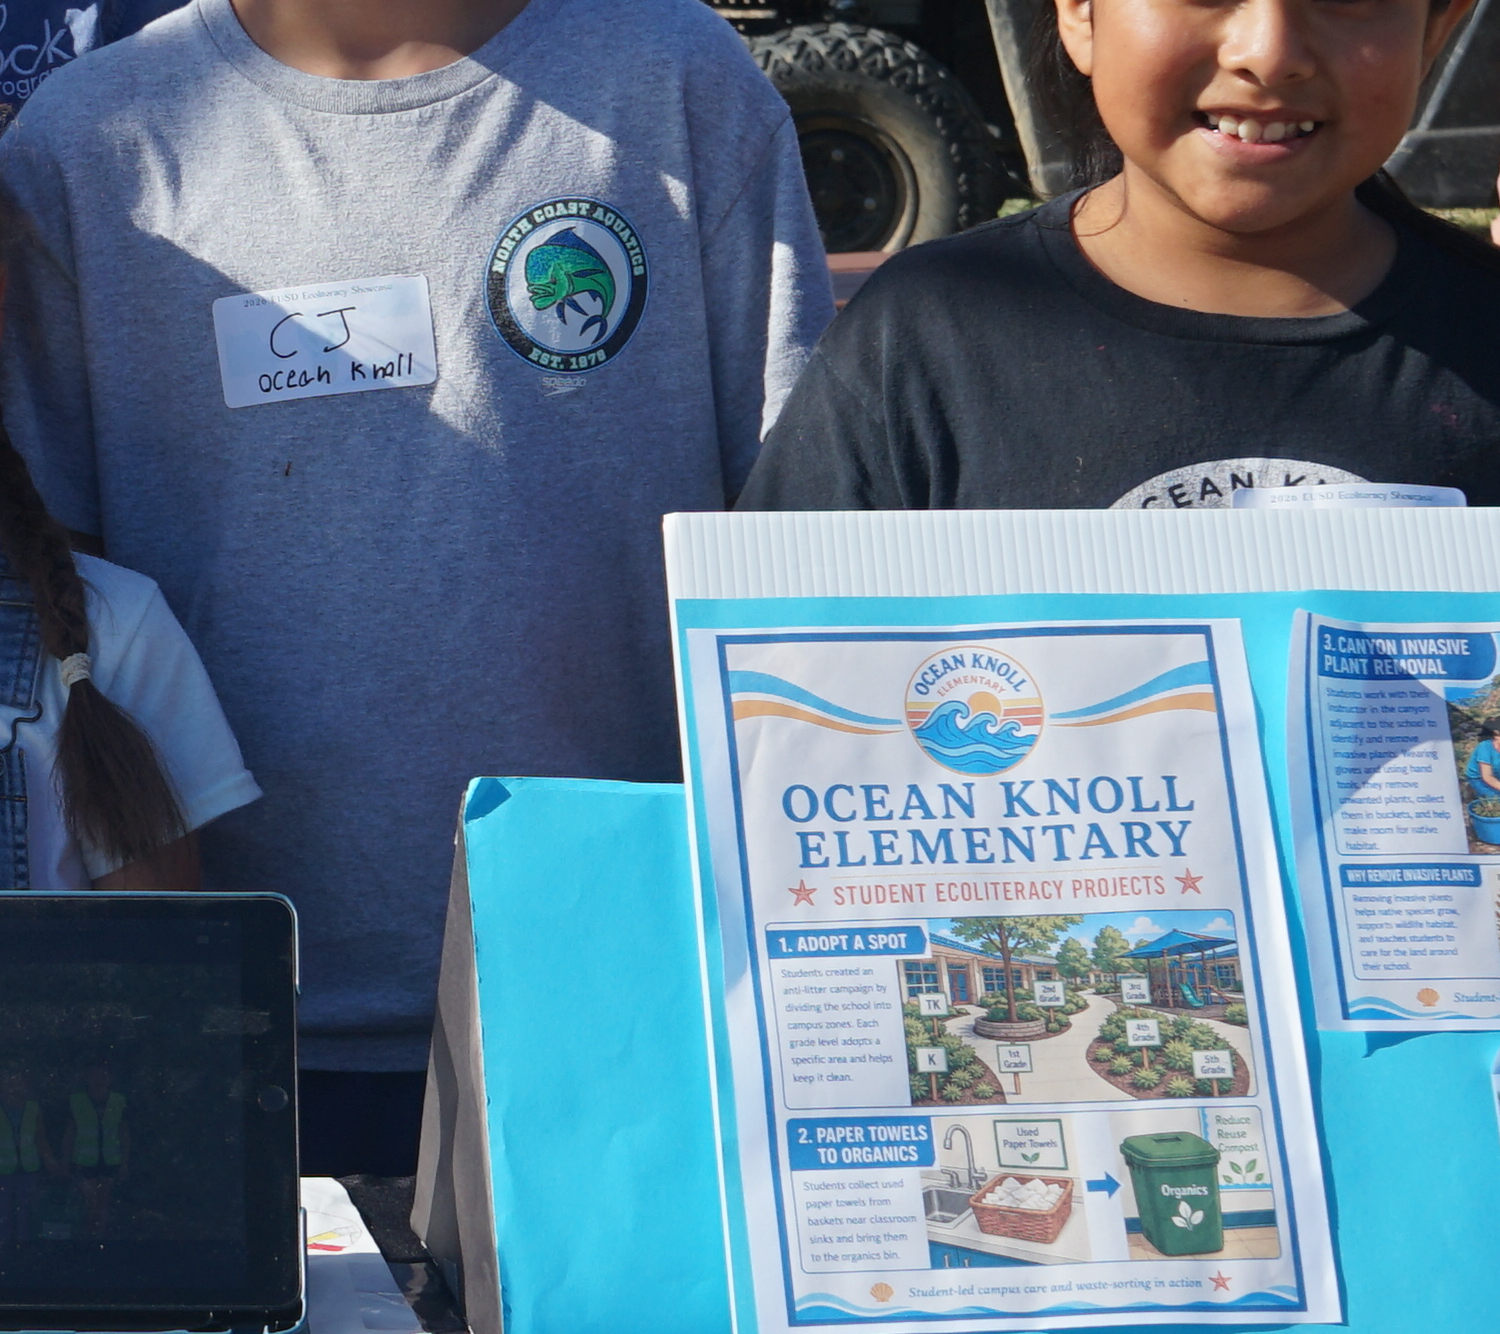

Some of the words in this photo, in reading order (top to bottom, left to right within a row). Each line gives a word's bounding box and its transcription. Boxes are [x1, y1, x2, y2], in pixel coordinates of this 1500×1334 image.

[493, 218, 533, 274] NORTH
[533, 202, 590, 223] COAST
[592, 207, 645, 276] AQUATICS
[270, 307, 356, 358] CJ
[528, 347, 564, 369] EST.
[1323, 633, 1336, 652] 3.
[1338, 637, 1397, 656] CANYON
[1400, 639, 1471, 656] INVASIVE
[1324, 654, 1369, 676] PLANT
[1372, 658, 1448, 676] REMOVAL
[914, 653, 967, 696] OCEAN
[971, 652, 1029, 694] KNOLL
[937, 675, 1006, 697] ELEMENTARY
[782, 782, 976, 823] OCEAN
[1000, 775, 1195, 819] KNOLL
[796, 820, 1193, 868] ELEMENTARY
[1368, 869, 1402, 882] REMOVE
[1403, 869, 1441, 882] INVASIVE
[1442, 868, 1475, 882] PLANTS
[834, 882, 927, 906] STUDENT
[936, 879, 1064, 903] ECOLITERACY
[1072, 875, 1166, 898] PROJECTS
[778, 937, 793, 953] 1.
[797, 935, 849, 952] ADOPT
[853, 934, 866, 951] A
[868, 933, 907, 950] SPOT
[781, 968, 823, 978] Students
[825, 967, 860, 977] created
[862, 968, 874, 976] an
[783, 985, 827, 995] anti-litter
[829, 985, 874, 995] campaign
[876, 983, 887, 994] by
[1040, 985, 1057, 995] 2nd
[1039, 994, 1062, 1004] Grade
[1126, 991, 1147, 1001] Grade
[785, 1002, 822, 1014] dividing
[824, 1002, 839, 1011] the
[841, 1000, 871, 1011] school
[873, 1000, 893, 1010] into
[925, 998, 942, 1011] TK
[787, 1021, 823, 1031] campus
[857, 1018, 879, 1028] Each
[789, 1038, 815, 1049] grade
[818, 1036, 838, 1047] level
[841, 1037, 873, 1048] adopts
[1132, 1032, 1157, 1043] Grade
[791, 1054, 826, 1066] specific
[828, 1055, 847, 1064] area
[850, 1053, 866, 1063] and
[868, 1052, 893, 1064] helps
[927, 1053, 938, 1066] K
[1008, 1049, 1021, 1059] 1st
[1204, 1054, 1221, 1064] 5th
[1004, 1058, 1028, 1069] Grade
[1200, 1063, 1227, 1074] Grade
[792, 1073, 814, 1084] keep
[817, 1072, 824, 1082] it
[826, 1072, 853, 1082] clean.
[1215, 1115, 1251, 1125] Reduce
[797, 1128, 813, 1144] 2.
[816, 1126, 865, 1143] PAPER
[867, 1124, 928, 1142] TOWELS
[1016, 1127, 1039, 1137] Used
[1217, 1129, 1247, 1139] Reuse
[1003, 1139, 1028, 1150] Paper
[1029, 1138, 1058, 1149] Towels
[1218, 1142, 1260, 1154] Compost
[817, 1147, 838, 1164] TO
[841, 1145, 919, 1163] ORGANICS
[1161, 1184, 1209, 1199] Organics
[908, 1284, 975, 1298] Student-led
[977, 1284, 1021, 1298] campus
[1024, 1283, 1047, 1293] care
[1050, 1280, 1073, 1292] and
[1076, 1276, 1152, 1291] waste-sorting
[1154, 1277, 1166, 1288] in
[1168, 1277, 1203, 1289] action
